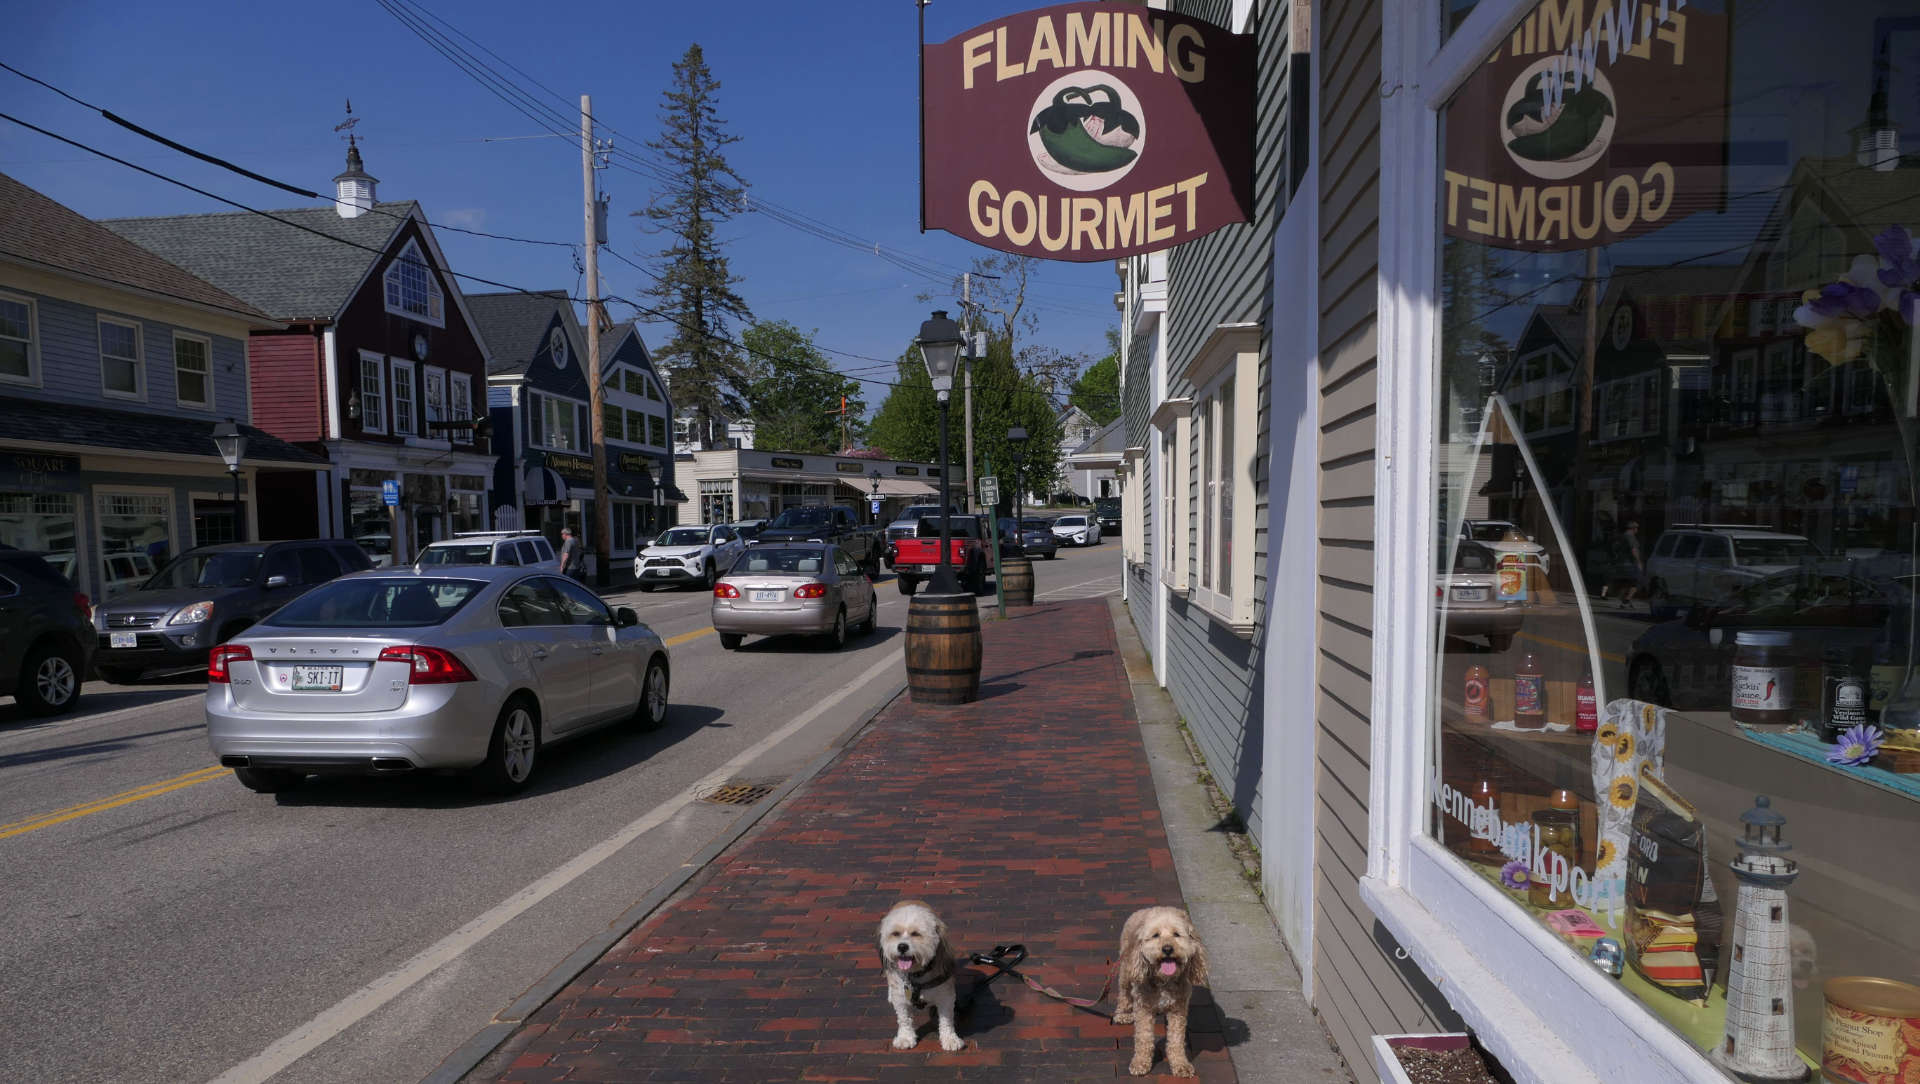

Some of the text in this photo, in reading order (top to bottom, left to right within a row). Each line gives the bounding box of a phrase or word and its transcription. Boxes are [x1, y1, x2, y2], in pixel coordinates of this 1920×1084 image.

[963, 12, 1206, 90] FLAMING
[968, 172, 1208, 252] GOURMET
[1861, 1024, 1885, 1037] Shop
